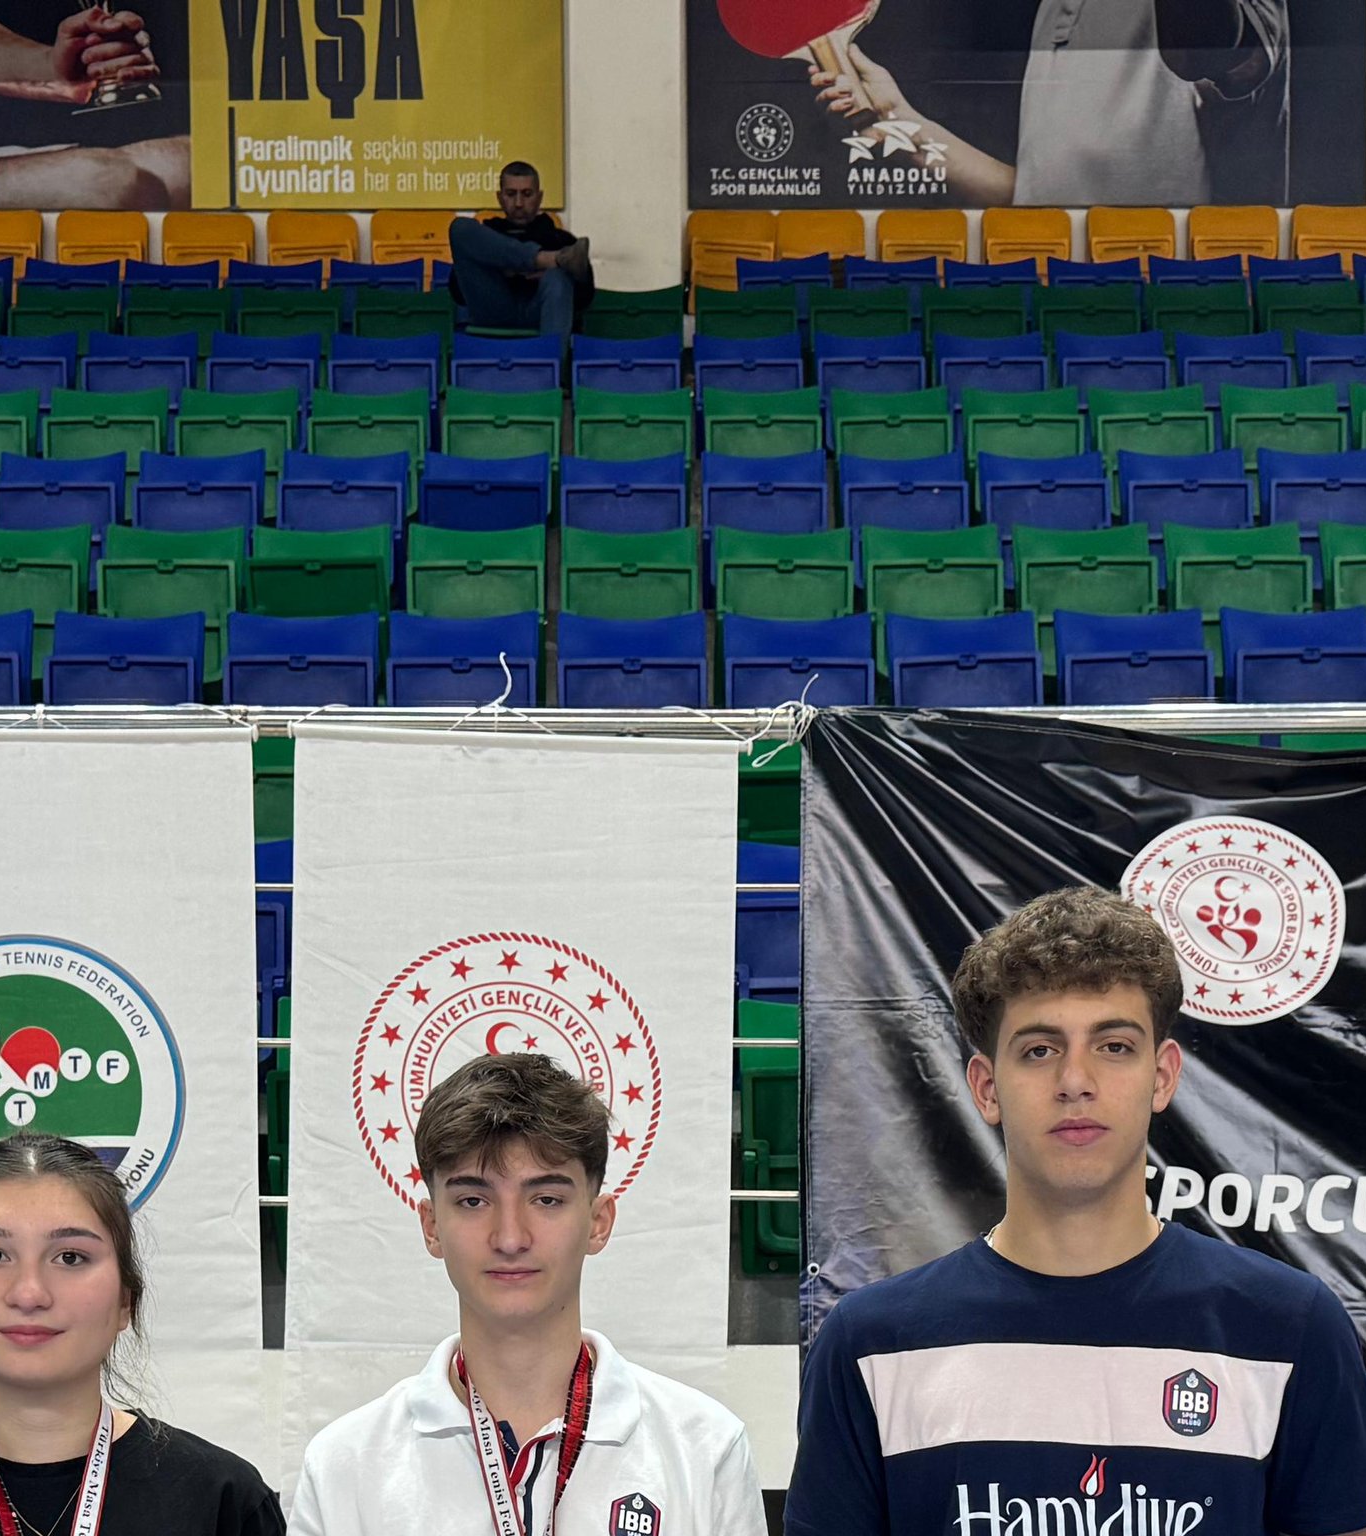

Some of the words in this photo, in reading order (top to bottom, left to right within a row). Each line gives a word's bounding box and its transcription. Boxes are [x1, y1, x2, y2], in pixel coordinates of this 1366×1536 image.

[220, 0, 424, 118] YAŞA
[238, 135, 353, 165] Paralimpik
[363, 136, 417, 166] seçkin
[239, 164, 354, 198] Oyunlarla
[364, 166, 390, 192] her
[397, 171, 417, 192] an
[423, 166, 450, 192] her
[710, 168, 735, 180] T.C.
[738, 166, 798, 182] GENÇLİK
[802, 168, 821, 180] VE
[710, 184, 745, 196] SPOR
[749, 182, 821, 196] BAKANLIĞI
[847, 167, 947, 182] ANADOLU
[847, 183, 947, 195] YILDIZLARI
[1209, 857, 1265, 875] GENÇLİK
[1269, 871, 1284, 887] VE
[1282, 886, 1298, 922] SPOR
[3, 952, 65, 968] TENNIS
[67, 961, 151, 1039] FEDERATION
[481, 989, 565, 1022] GENÇLİK
[564, 1015, 586, 1042] VE
[580, 1041, 605, 1094] SPOR
[488, 1459, 509, 1507] Tenisi
